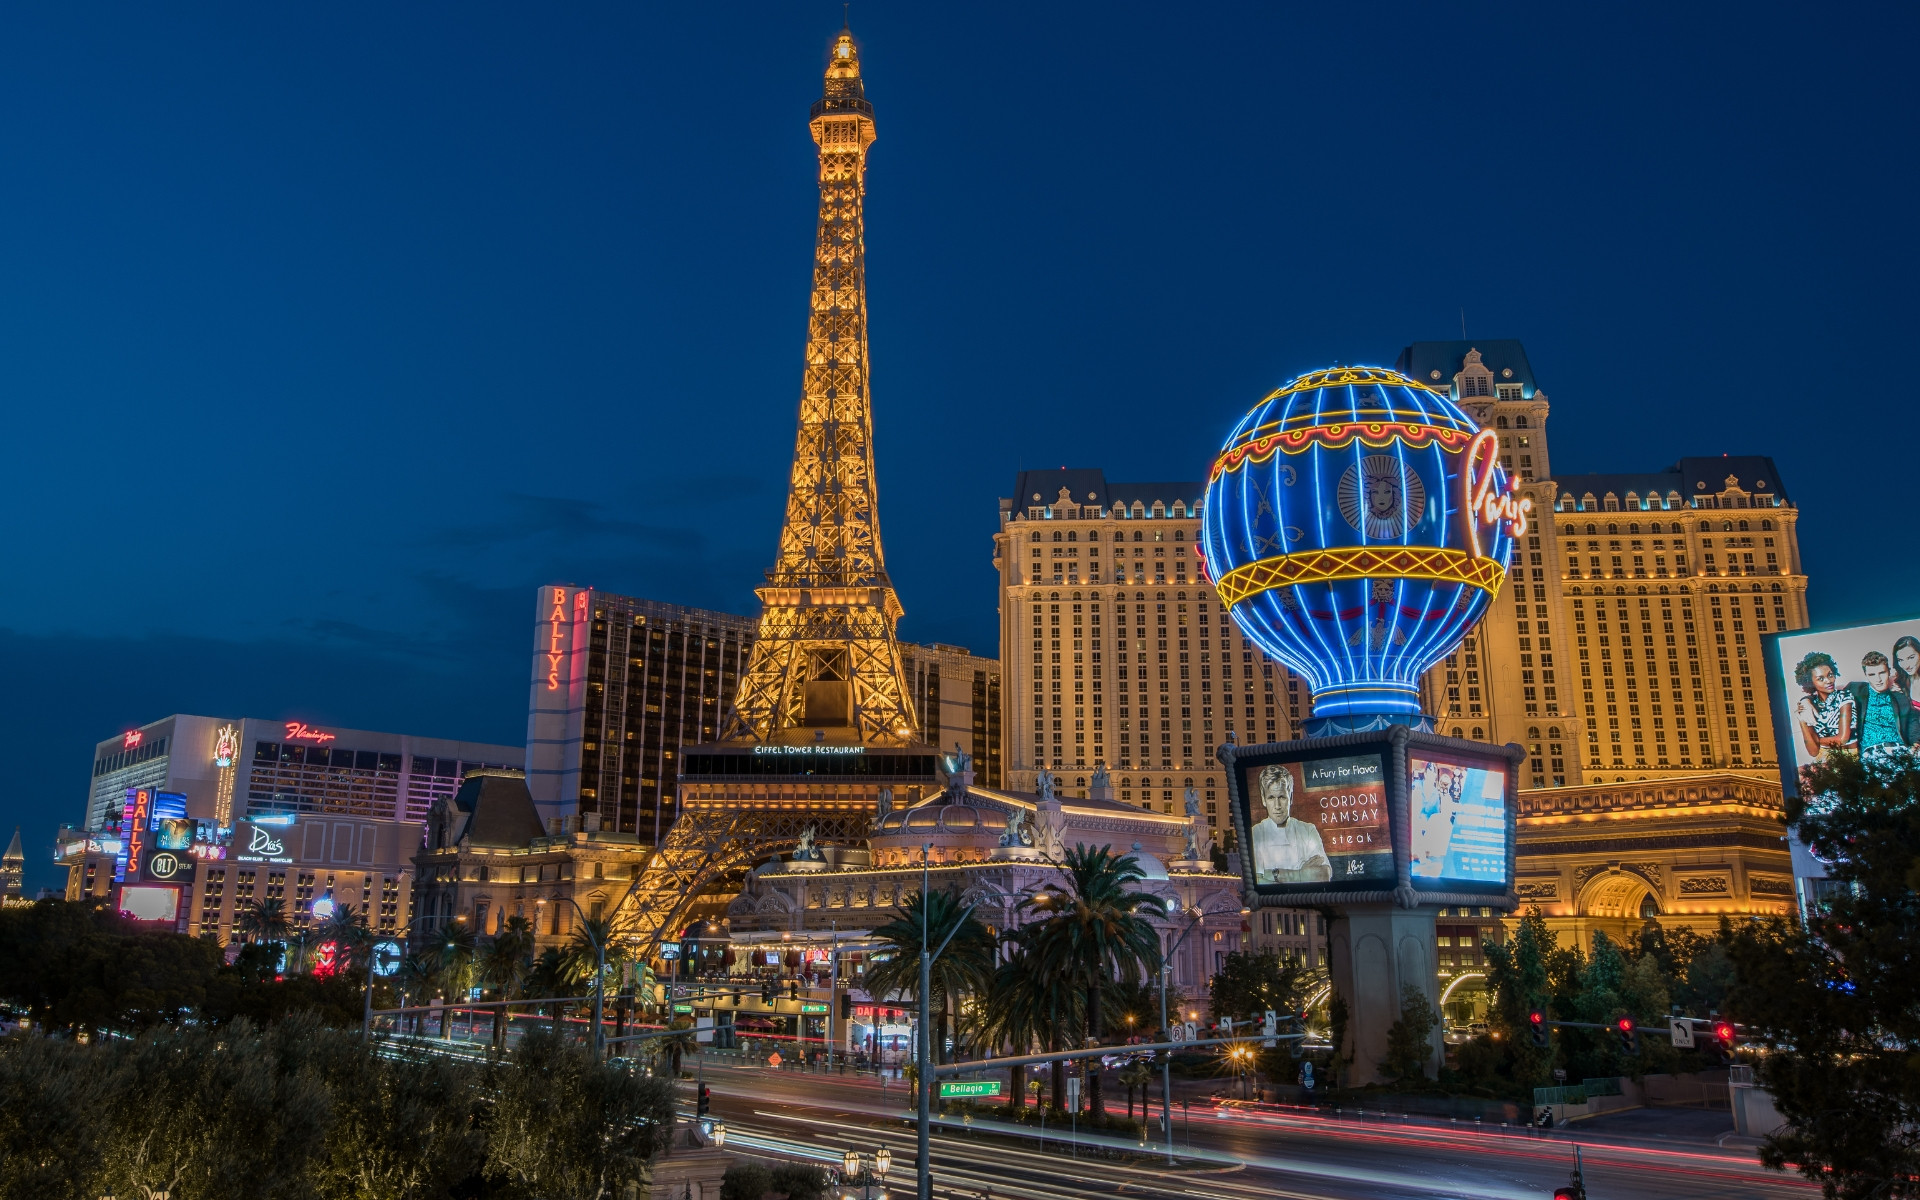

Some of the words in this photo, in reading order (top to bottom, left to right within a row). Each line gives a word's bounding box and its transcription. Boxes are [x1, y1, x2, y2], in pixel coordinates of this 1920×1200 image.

[1465, 429, 1531, 558] Paris
[285, 722, 335, 743] Flamingo
[754, 745, 782, 754] EIFFEL
[783, 745, 812, 754] TOWER
[815, 745, 865, 754] RESTAURANT
[1312, 770, 1319, 779] A
[1320, 768, 1336, 779] Fury
[1338, 766, 1350, 776] For
[1352, 765, 1378, 775] Flavor
[1320, 793, 1378, 809] GORDON
[1321, 808, 1378, 824] RAMSAY
[1332, 833, 1372, 845] steak
[156, 858, 172, 873] BLT
[950, 1084, 983, 1094] Bellagio
